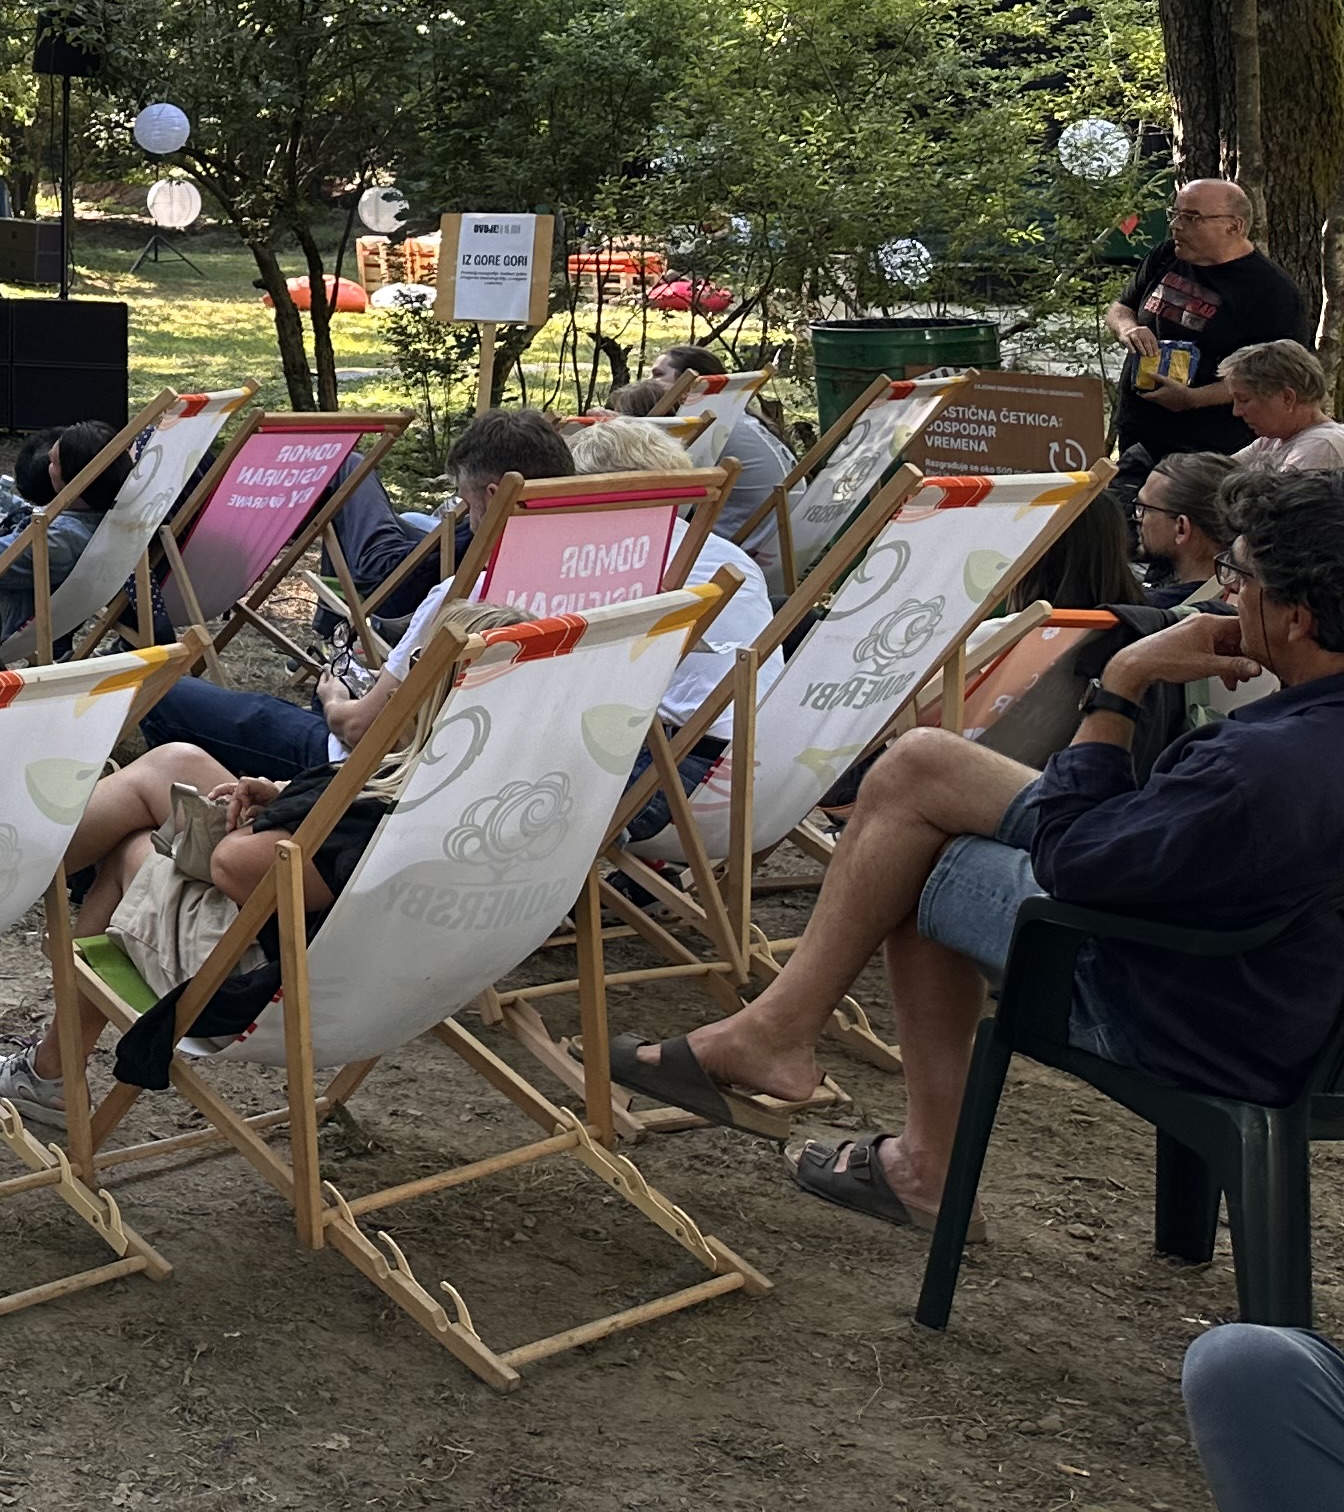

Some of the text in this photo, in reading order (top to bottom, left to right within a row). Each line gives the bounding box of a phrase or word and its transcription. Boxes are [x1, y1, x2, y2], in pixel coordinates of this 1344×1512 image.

[462, 254, 528, 267] IZ GORE GORI
[939, 405, 997, 422] ASTIČNA
[924, 434, 989, 453] VREMENA
